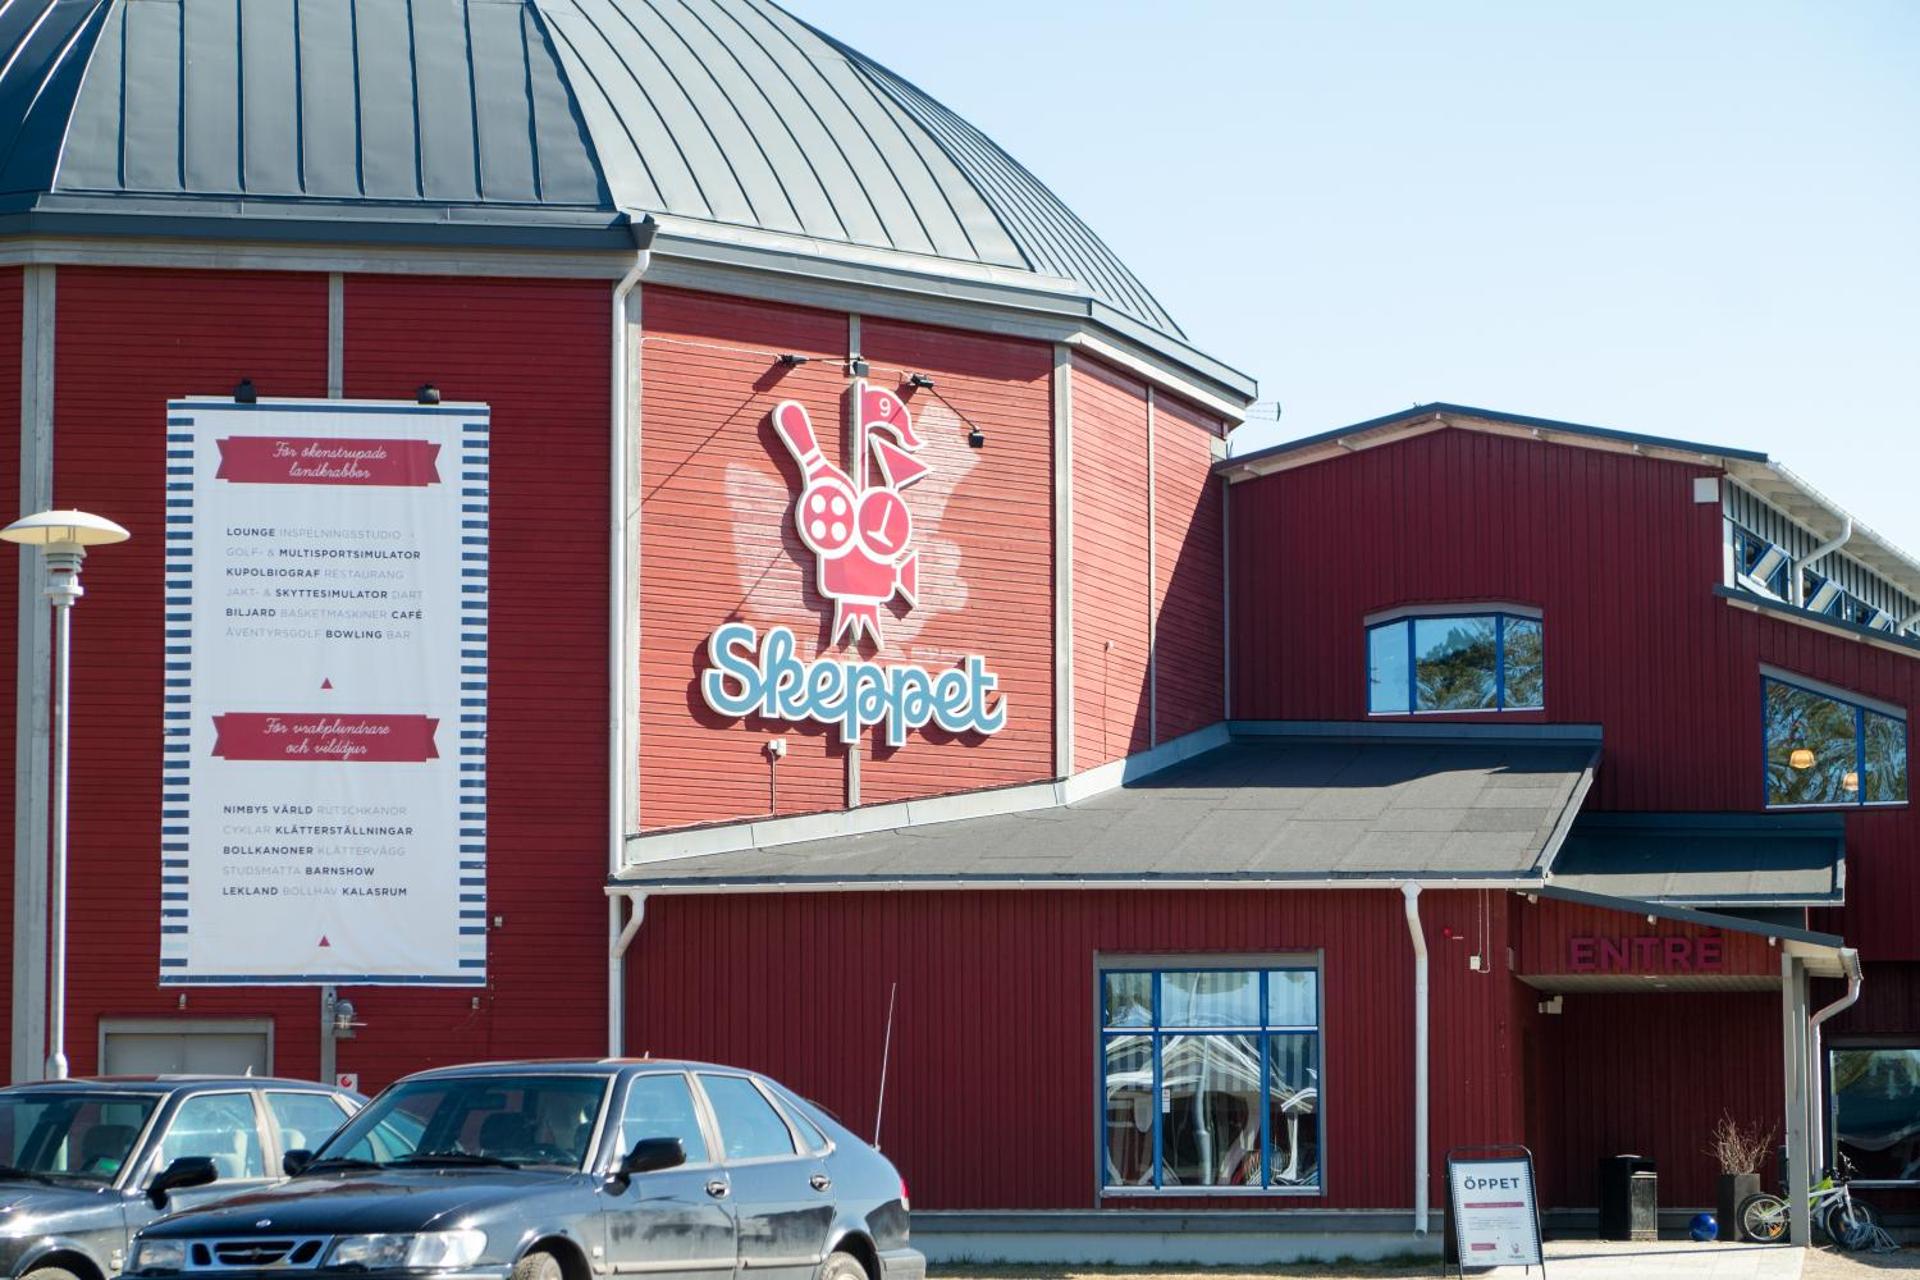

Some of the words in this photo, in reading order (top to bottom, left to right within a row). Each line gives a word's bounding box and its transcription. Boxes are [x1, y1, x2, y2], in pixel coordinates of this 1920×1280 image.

[272, 440, 297, 458] För
[226, 528, 275, 537] LOUNGE
[279, 548, 421, 559] MULTISPORTSIMULATOR
[226, 567, 321, 577] KUPOLBIOGRAF
[324, 569, 405, 580] RESTAURANG
[275, 588, 388, 599] SKYTTESIMULATOR
[226, 607, 276, 617] BILJARD
[391, 608, 423, 619] CAFÉ
[325, 629, 383, 639] BOWLING
[702, 622, 1008, 746] Skeppet
[263, 717, 288, 735] För
[285, 738, 308, 755] och
[223, 805, 269, 814] NIMBYS
[272, 803, 313, 815] VÄRLD
[275, 824, 414, 836] KLÄTTERSTÄLLNINGAR
[223, 846, 314, 855] BOLLKANONER
[305, 866, 375, 876] BARNSHOW
[222, 886, 279, 896] LEKLAND
[342, 886, 407, 897] KALASRUM
[1570, 927, 1724, 971] ENTRÉ
[1463, 1175, 1520, 1190] ÖPPET
